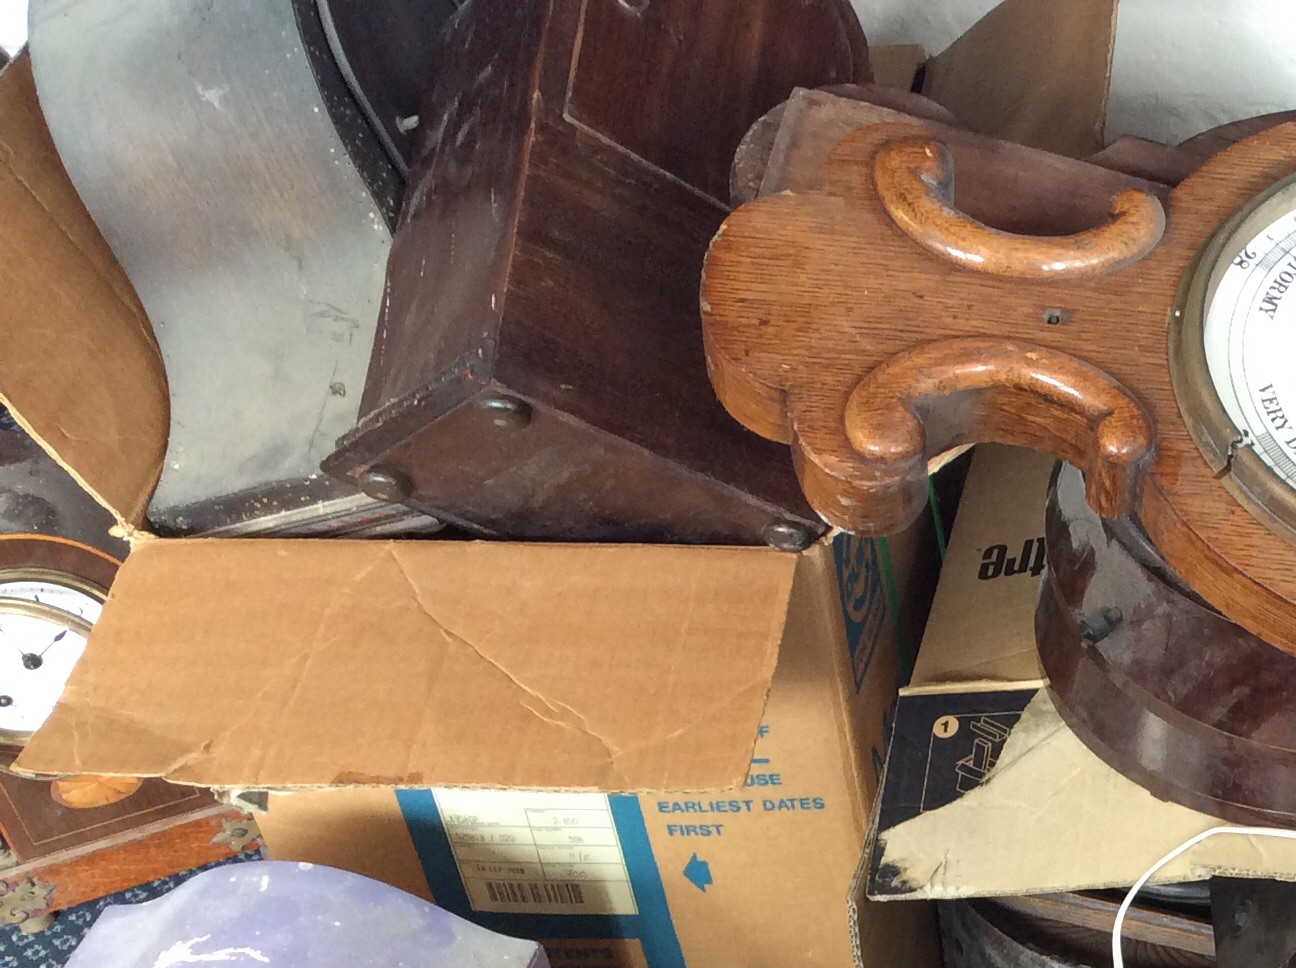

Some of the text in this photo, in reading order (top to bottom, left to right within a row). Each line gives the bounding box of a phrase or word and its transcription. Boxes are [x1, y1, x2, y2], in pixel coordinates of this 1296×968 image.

[1231, 247, 1257, 271] 28
[1256, 382, 1293, 432] VERY
[940, 719, 950, 733] 1
[657, 797, 826, 814] EARLIEST DATES
[666, 823, 725, 838] FIRST
